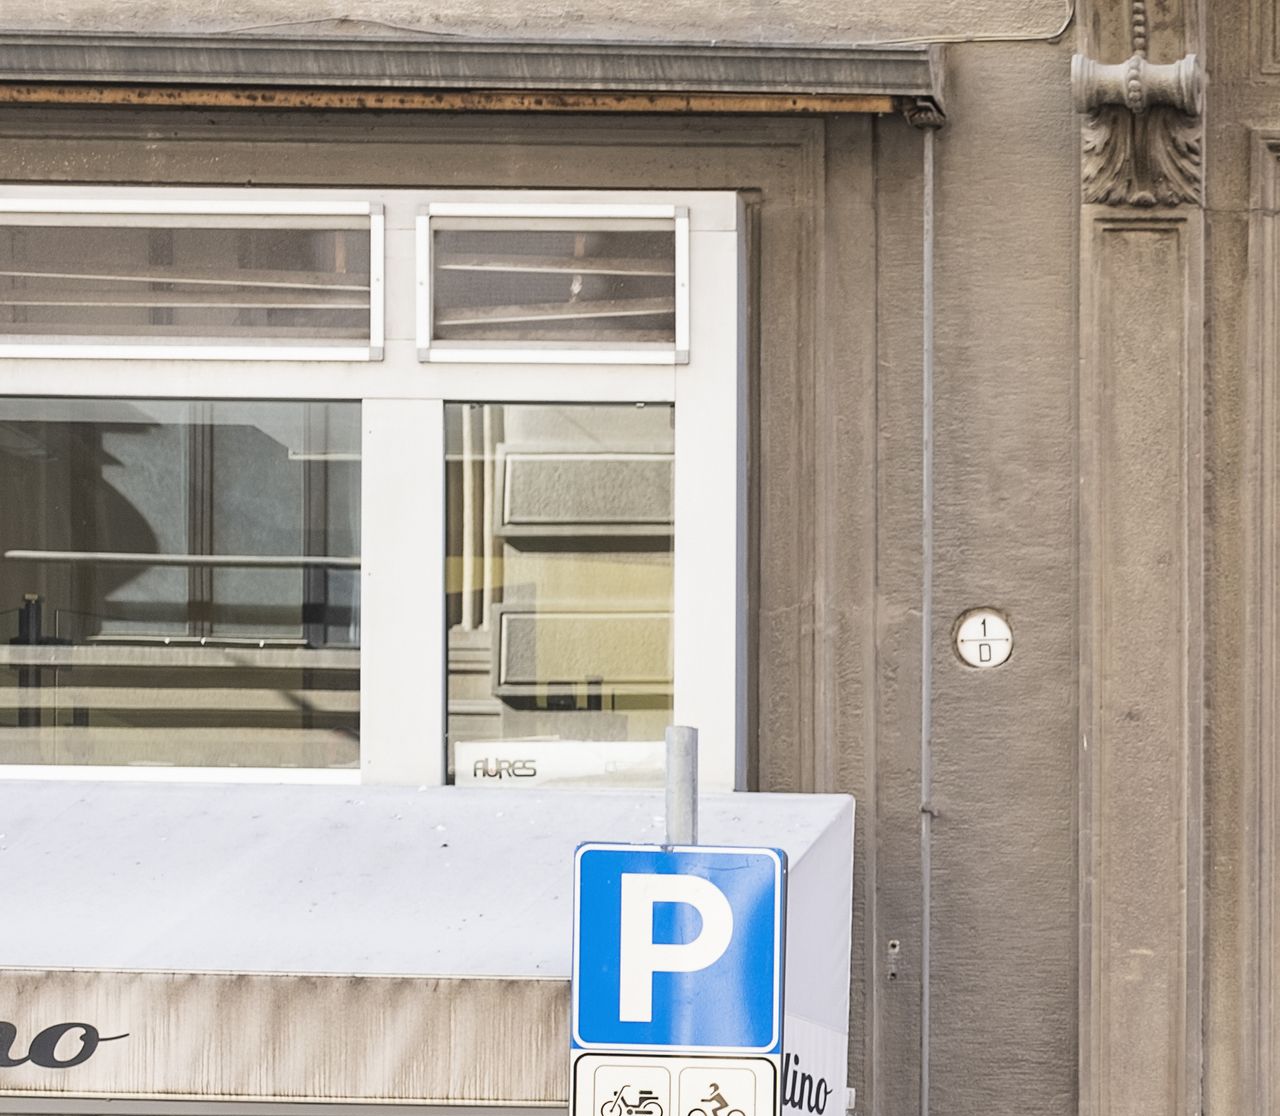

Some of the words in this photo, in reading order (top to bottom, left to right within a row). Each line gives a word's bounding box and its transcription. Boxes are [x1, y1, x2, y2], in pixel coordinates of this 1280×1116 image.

[981, 618, 987, 637] 1
[473, 757, 537, 780] AURES
[618, 872, 734, 1023] P
